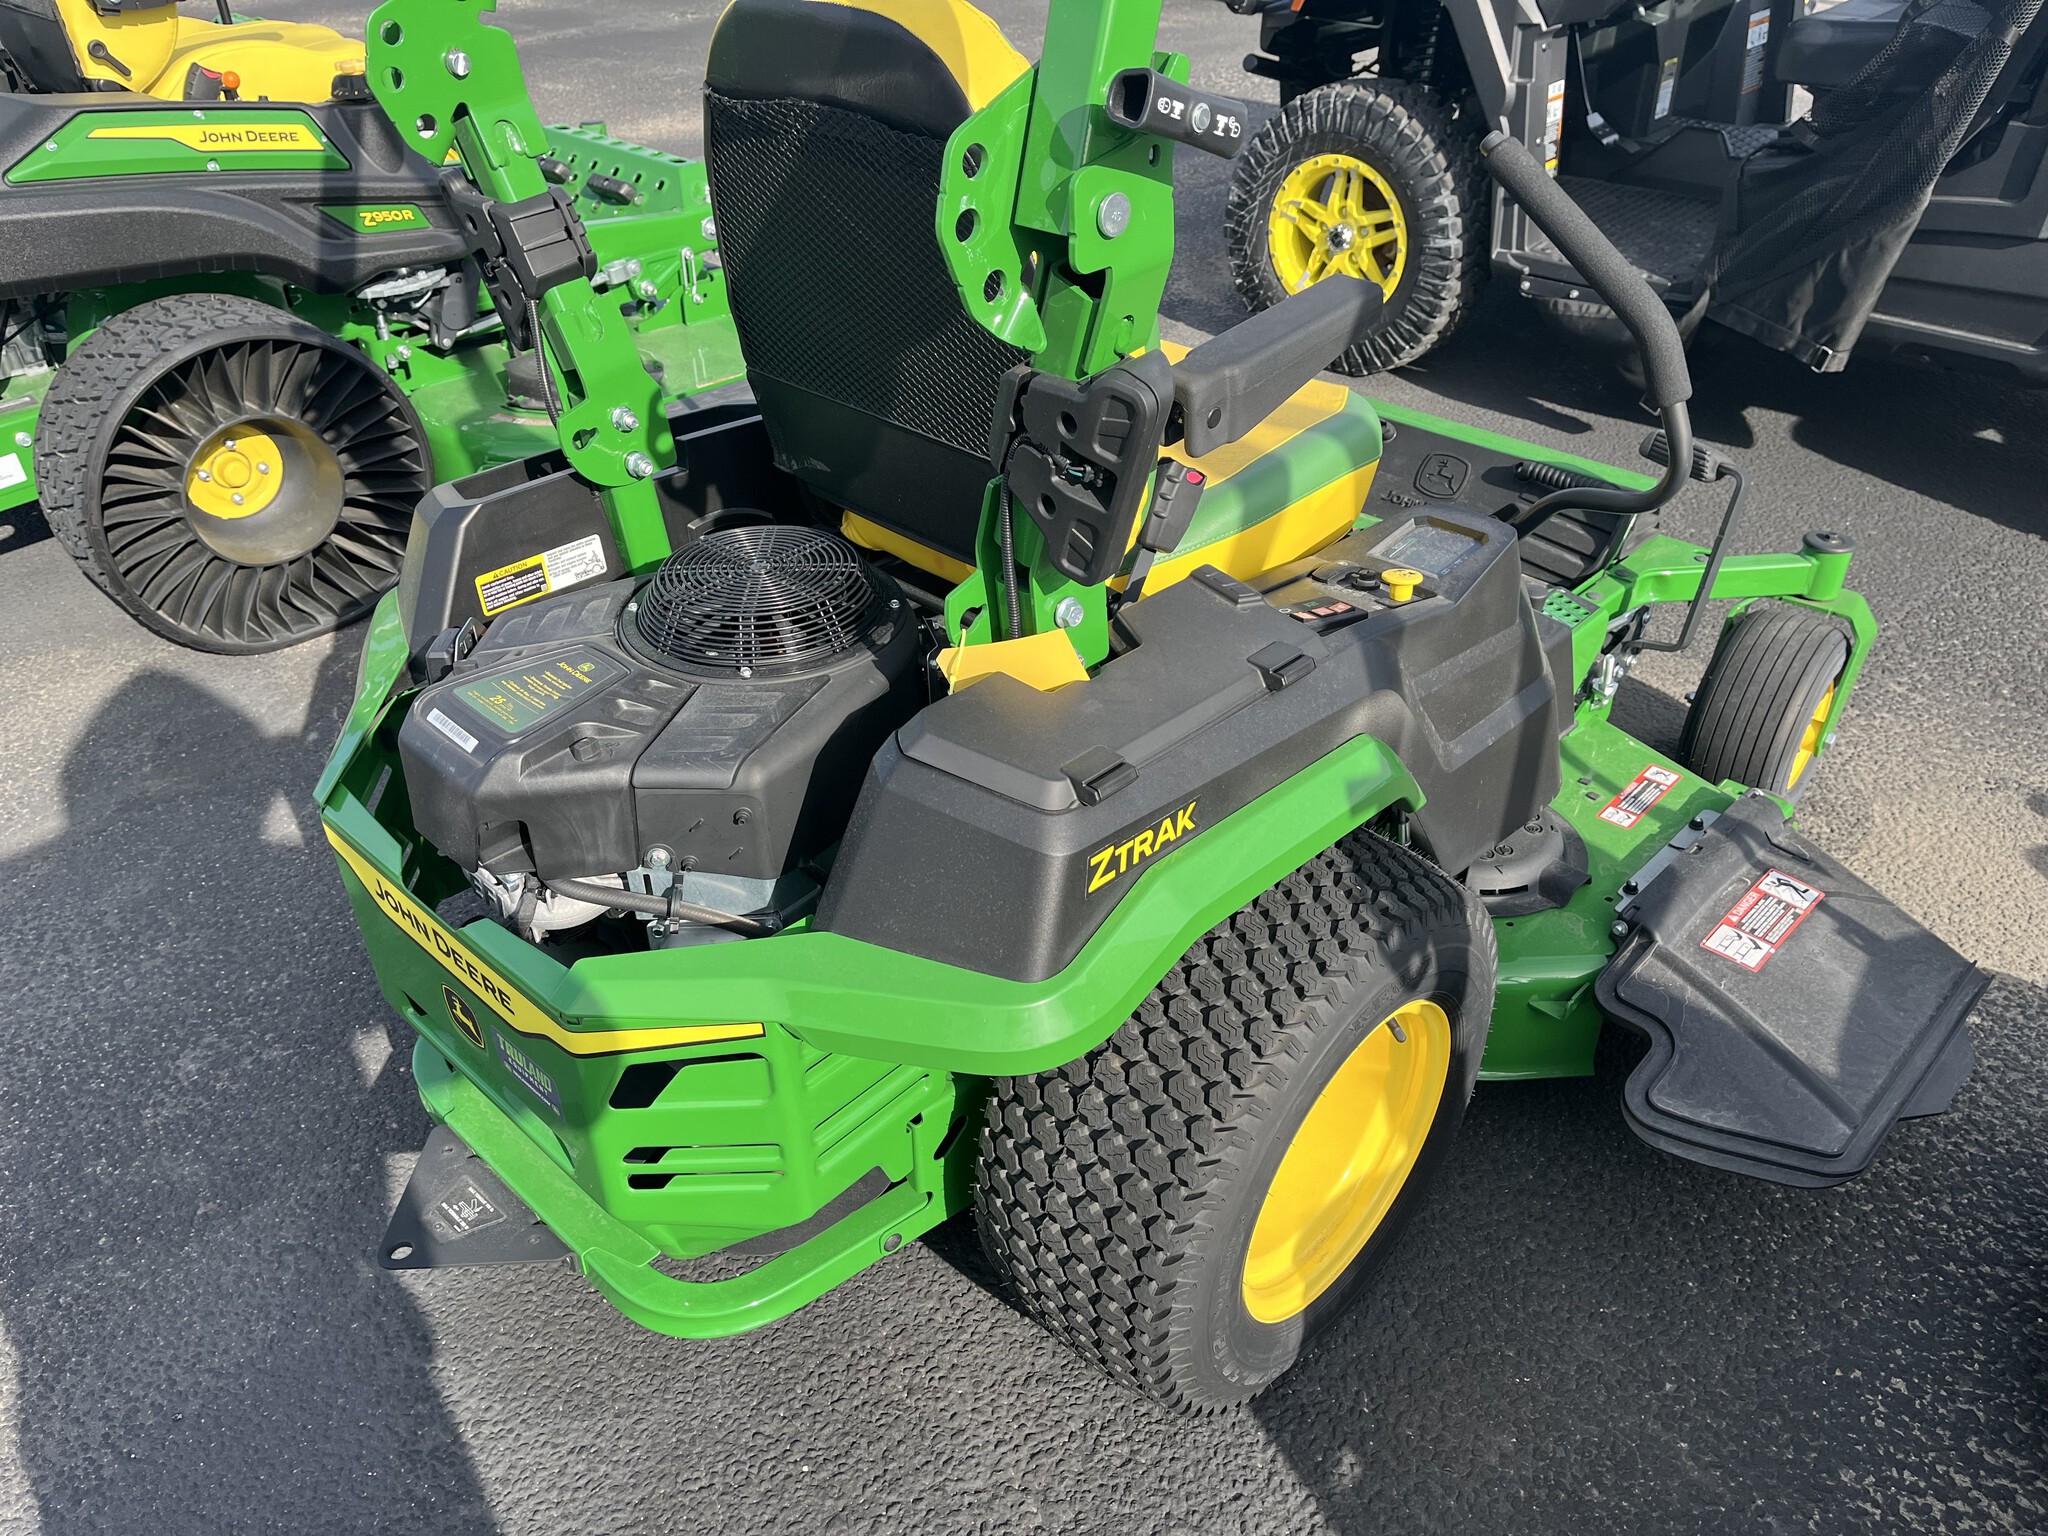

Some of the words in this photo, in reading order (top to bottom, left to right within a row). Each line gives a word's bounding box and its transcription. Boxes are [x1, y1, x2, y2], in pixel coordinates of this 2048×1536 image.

[199, 131, 243, 143] JOHN
[245, 130, 300, 142] DEERE
[359, 209, 415, 227] Z950R
[499, 562, 528, 577] CAUTION
[557, 661, 575, 675] JOHN
[572, 668, 593, 684] DEERE
[489, 694, 507, 704] 25
[1088, 801, 1197, 893] ZTRAK
[1732, 891, 1761, 918] DANGER
[375, 878, 431, 942] JOHN
[431, 928, 516, 1016] DEERE
[496, 1033, 552, 1093] TRULAND
